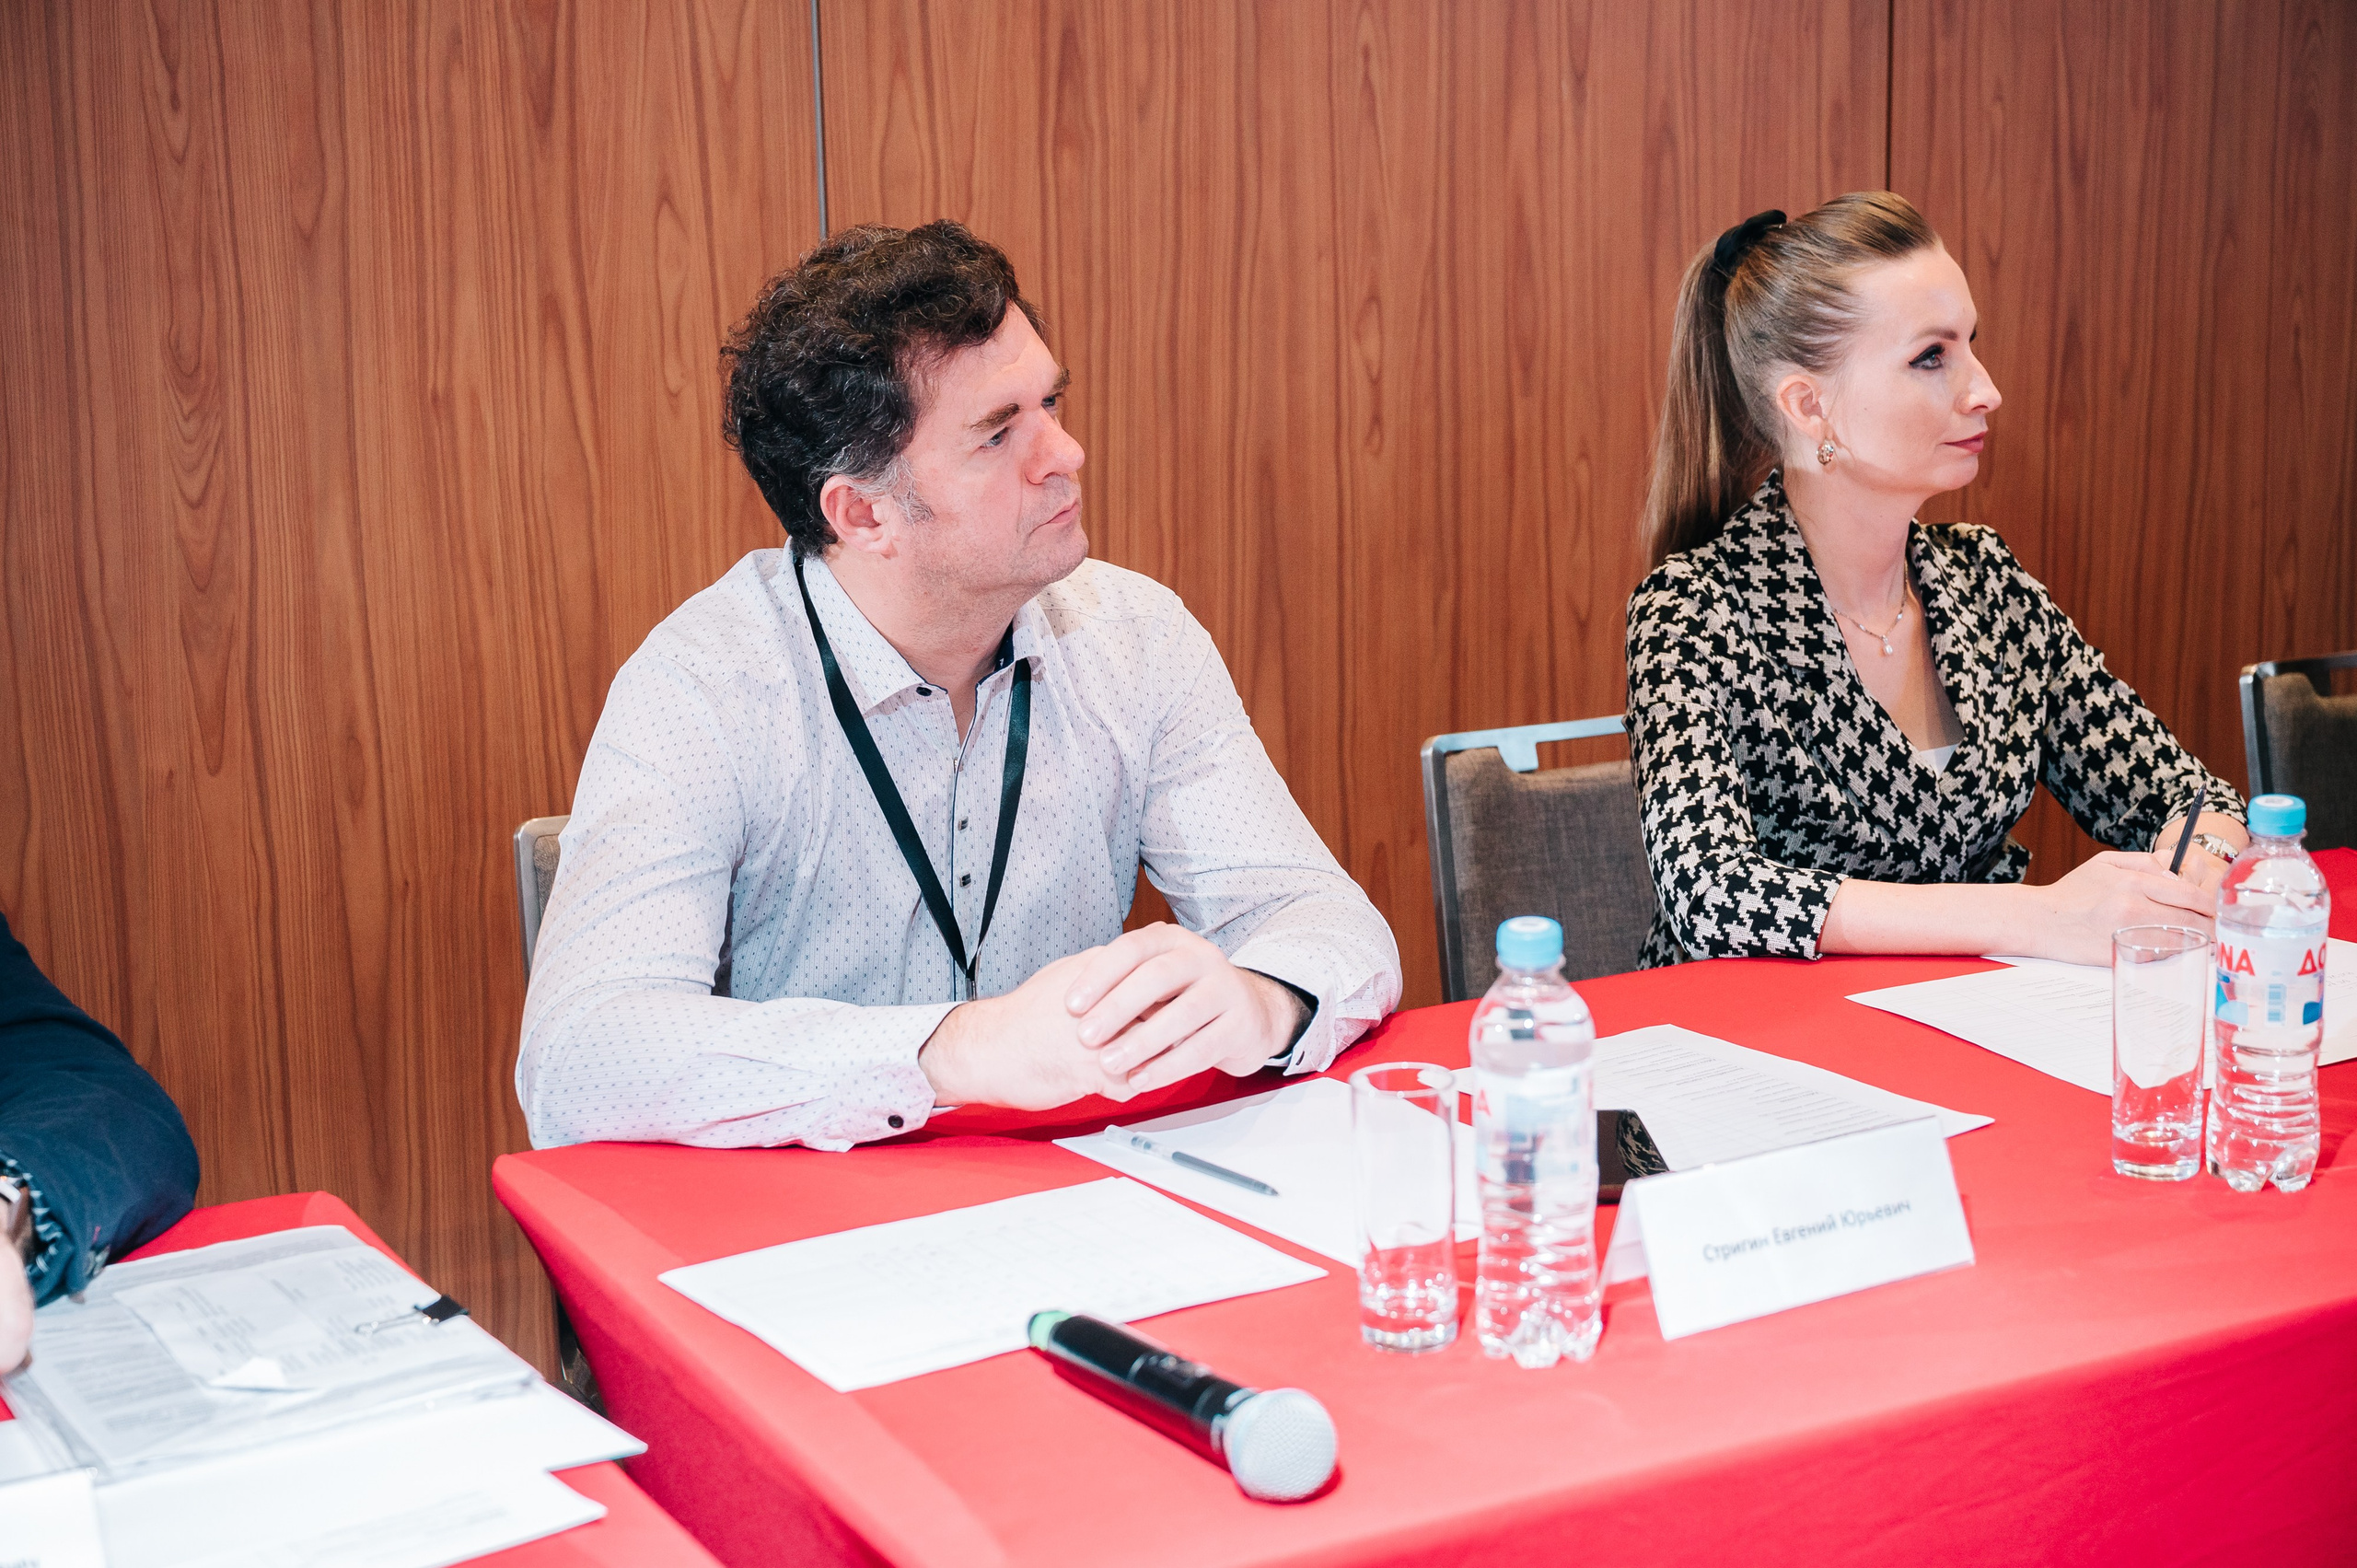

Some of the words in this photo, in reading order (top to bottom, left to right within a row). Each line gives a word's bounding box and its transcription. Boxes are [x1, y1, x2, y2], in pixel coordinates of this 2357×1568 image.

[1702, 1237, 1770, 1262] Стригин
[1772, 1214, 1837, 1245] Евгений
[1840, 1200, 1911, 1228] Юрьевич
